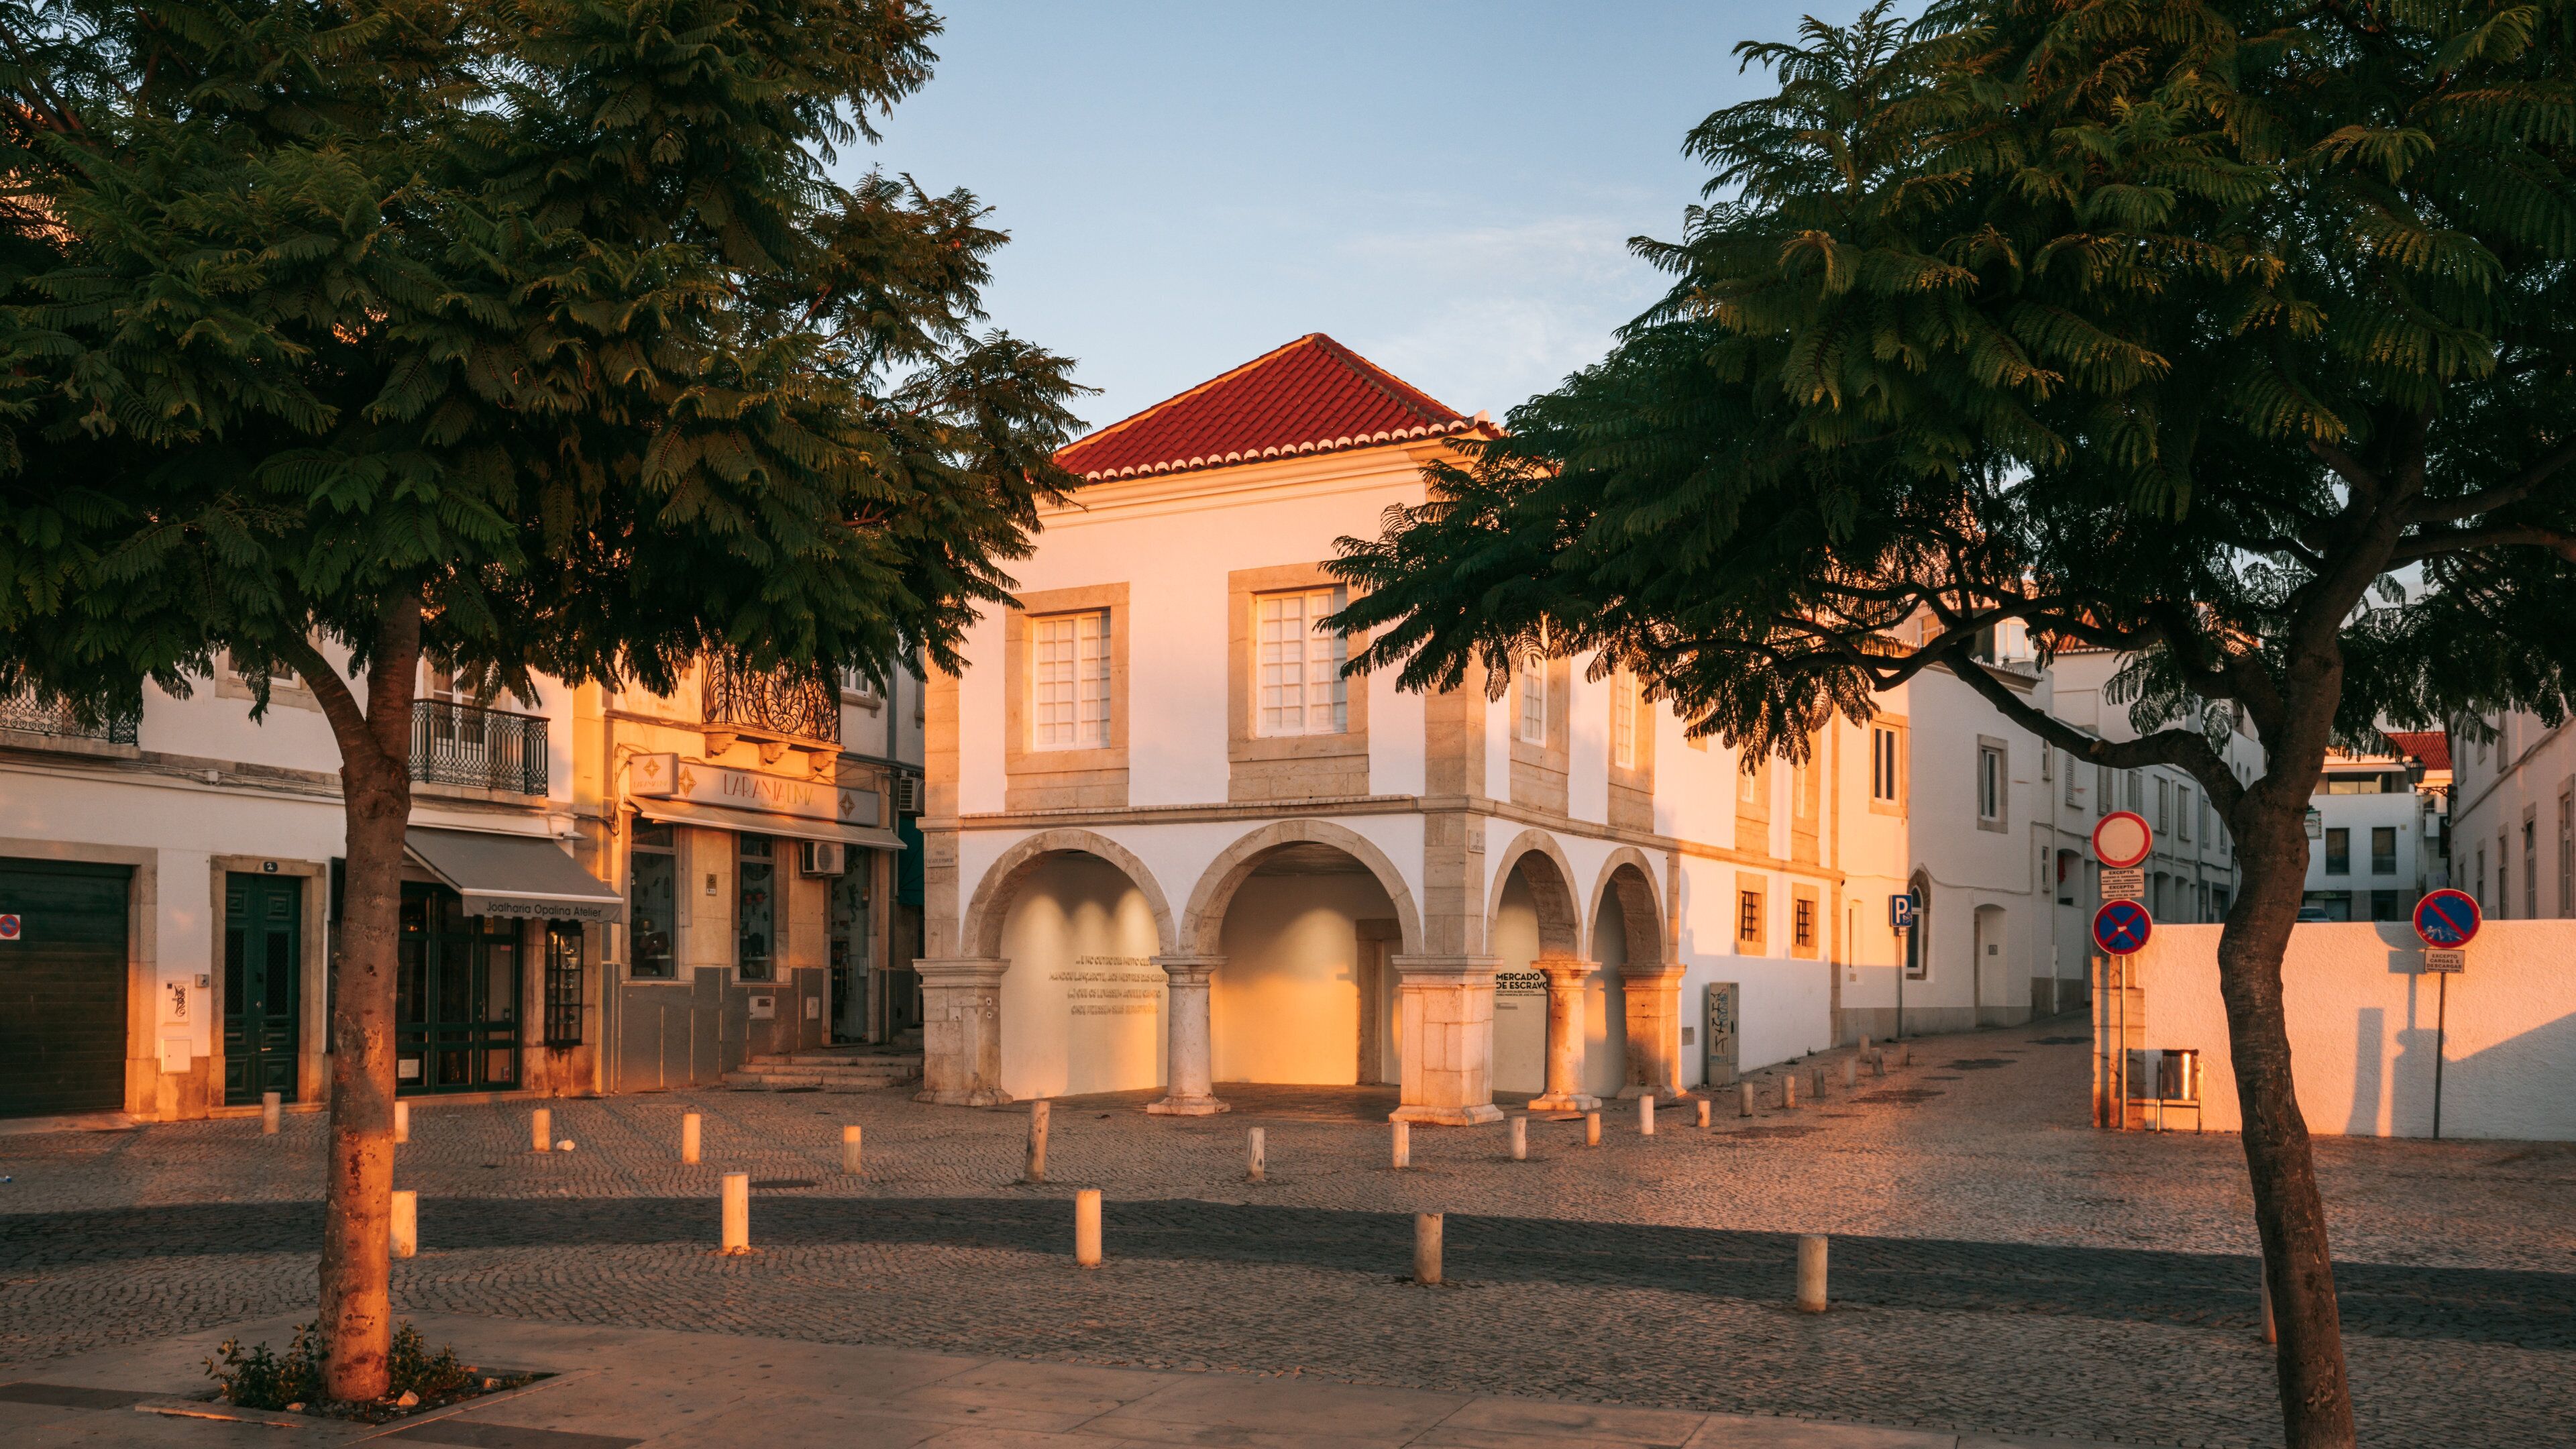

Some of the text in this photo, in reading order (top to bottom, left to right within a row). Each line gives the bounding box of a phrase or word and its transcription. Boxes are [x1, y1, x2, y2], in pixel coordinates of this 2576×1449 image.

[486, 901, 602, 918] Joalharia Opalina Atelier
[1895, 898, 1909, 923] P
[1509, 981, 1547, 989] ESCRAVO
